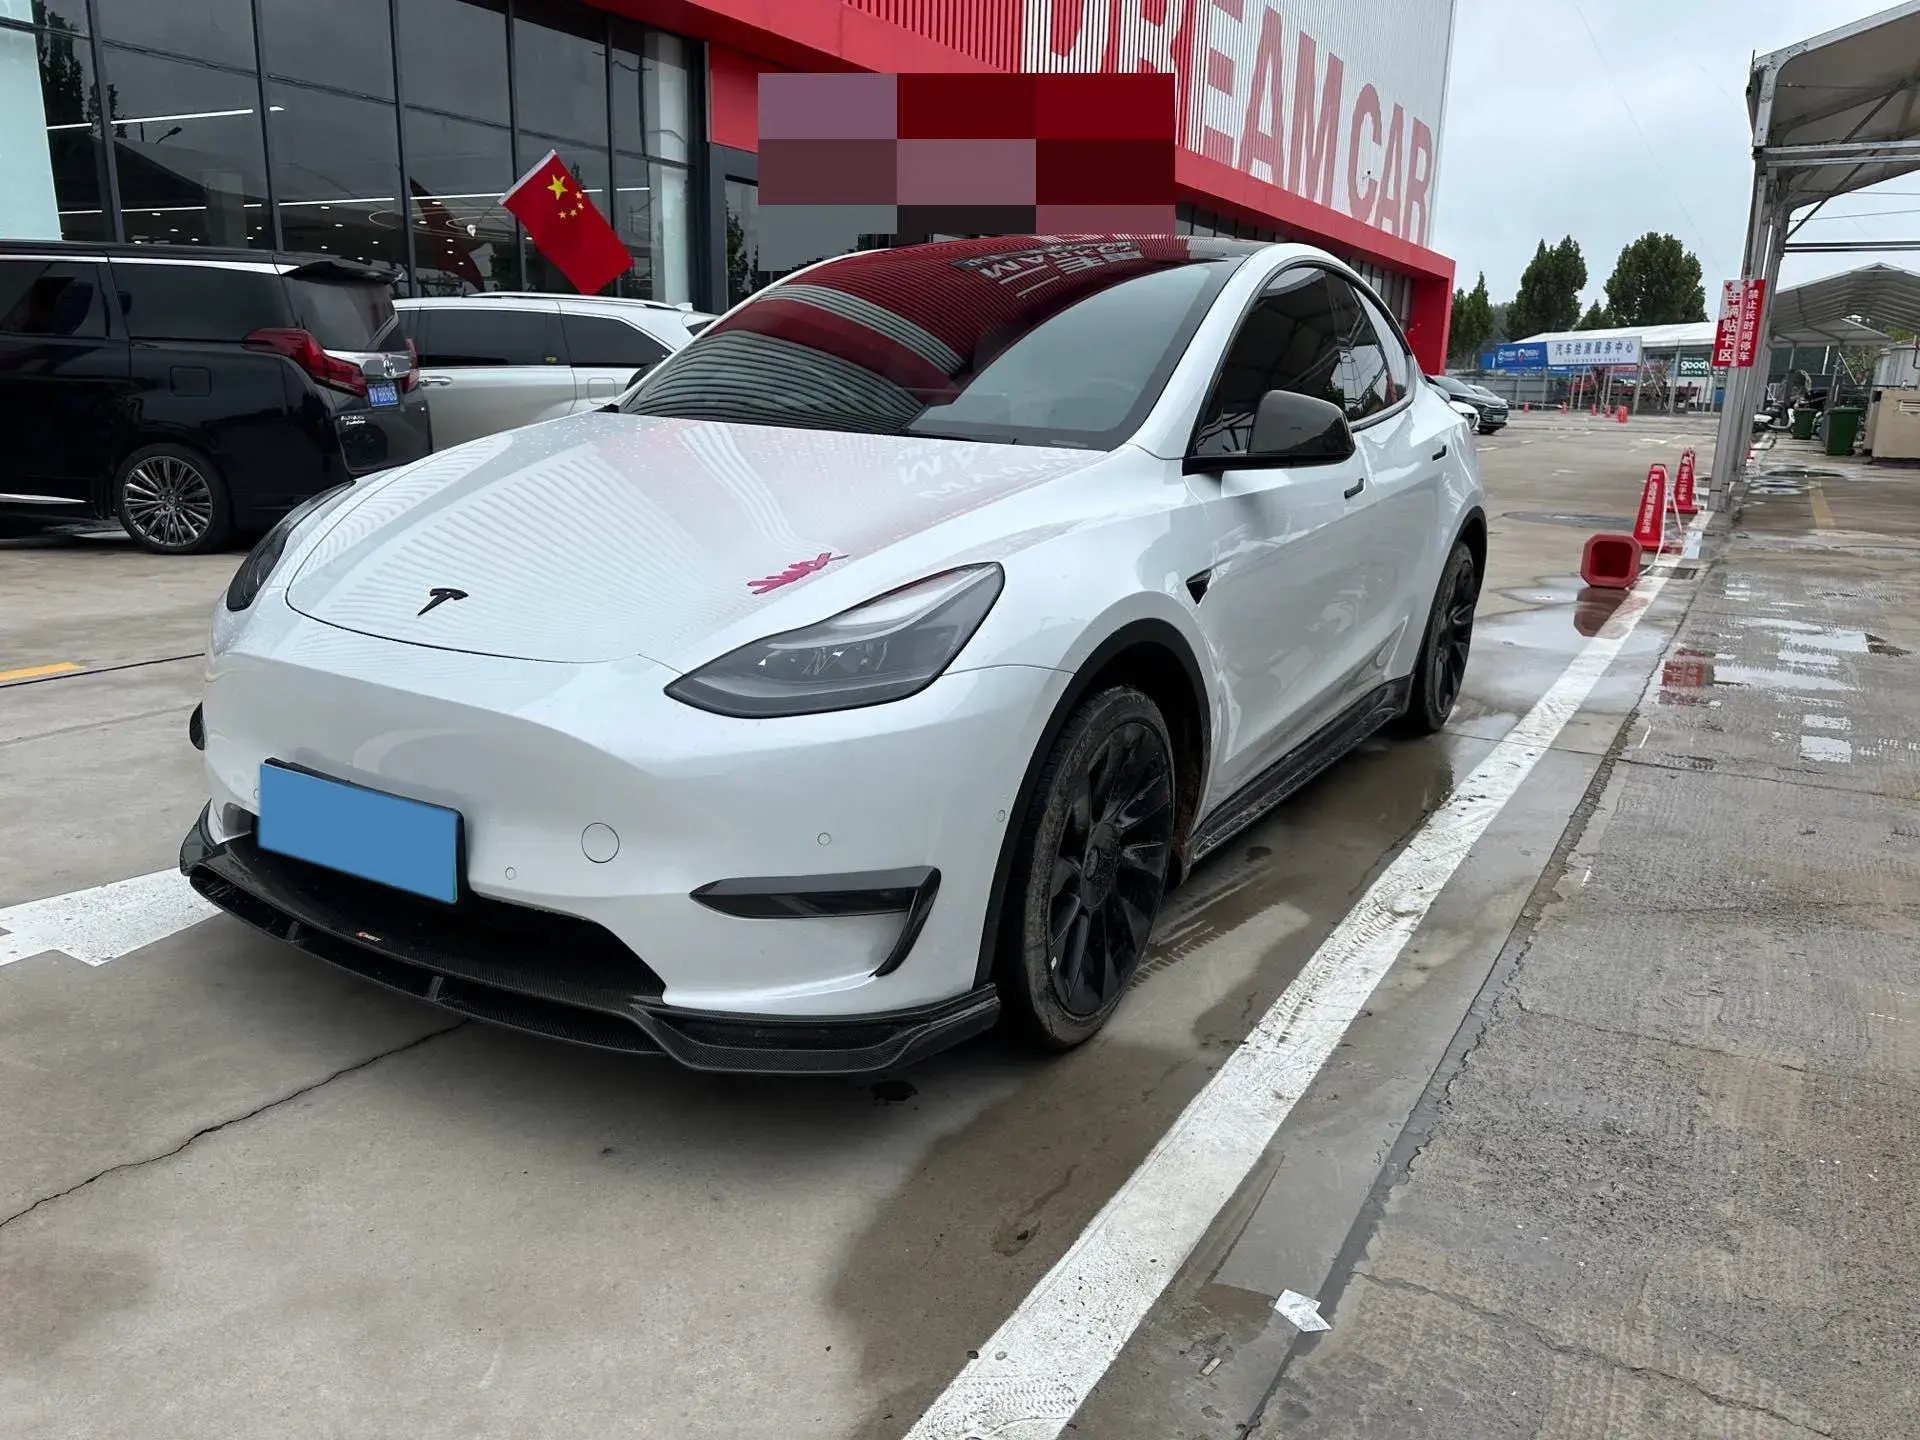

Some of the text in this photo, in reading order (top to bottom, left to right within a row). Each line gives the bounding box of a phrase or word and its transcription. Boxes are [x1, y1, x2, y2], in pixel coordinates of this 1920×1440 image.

[1347, 83, 1433, 244] CAR
[1555, 341, 1634, 356] 汽车检测服务中心
[1738, 289, 1759, 361] 禁止长时间停车
